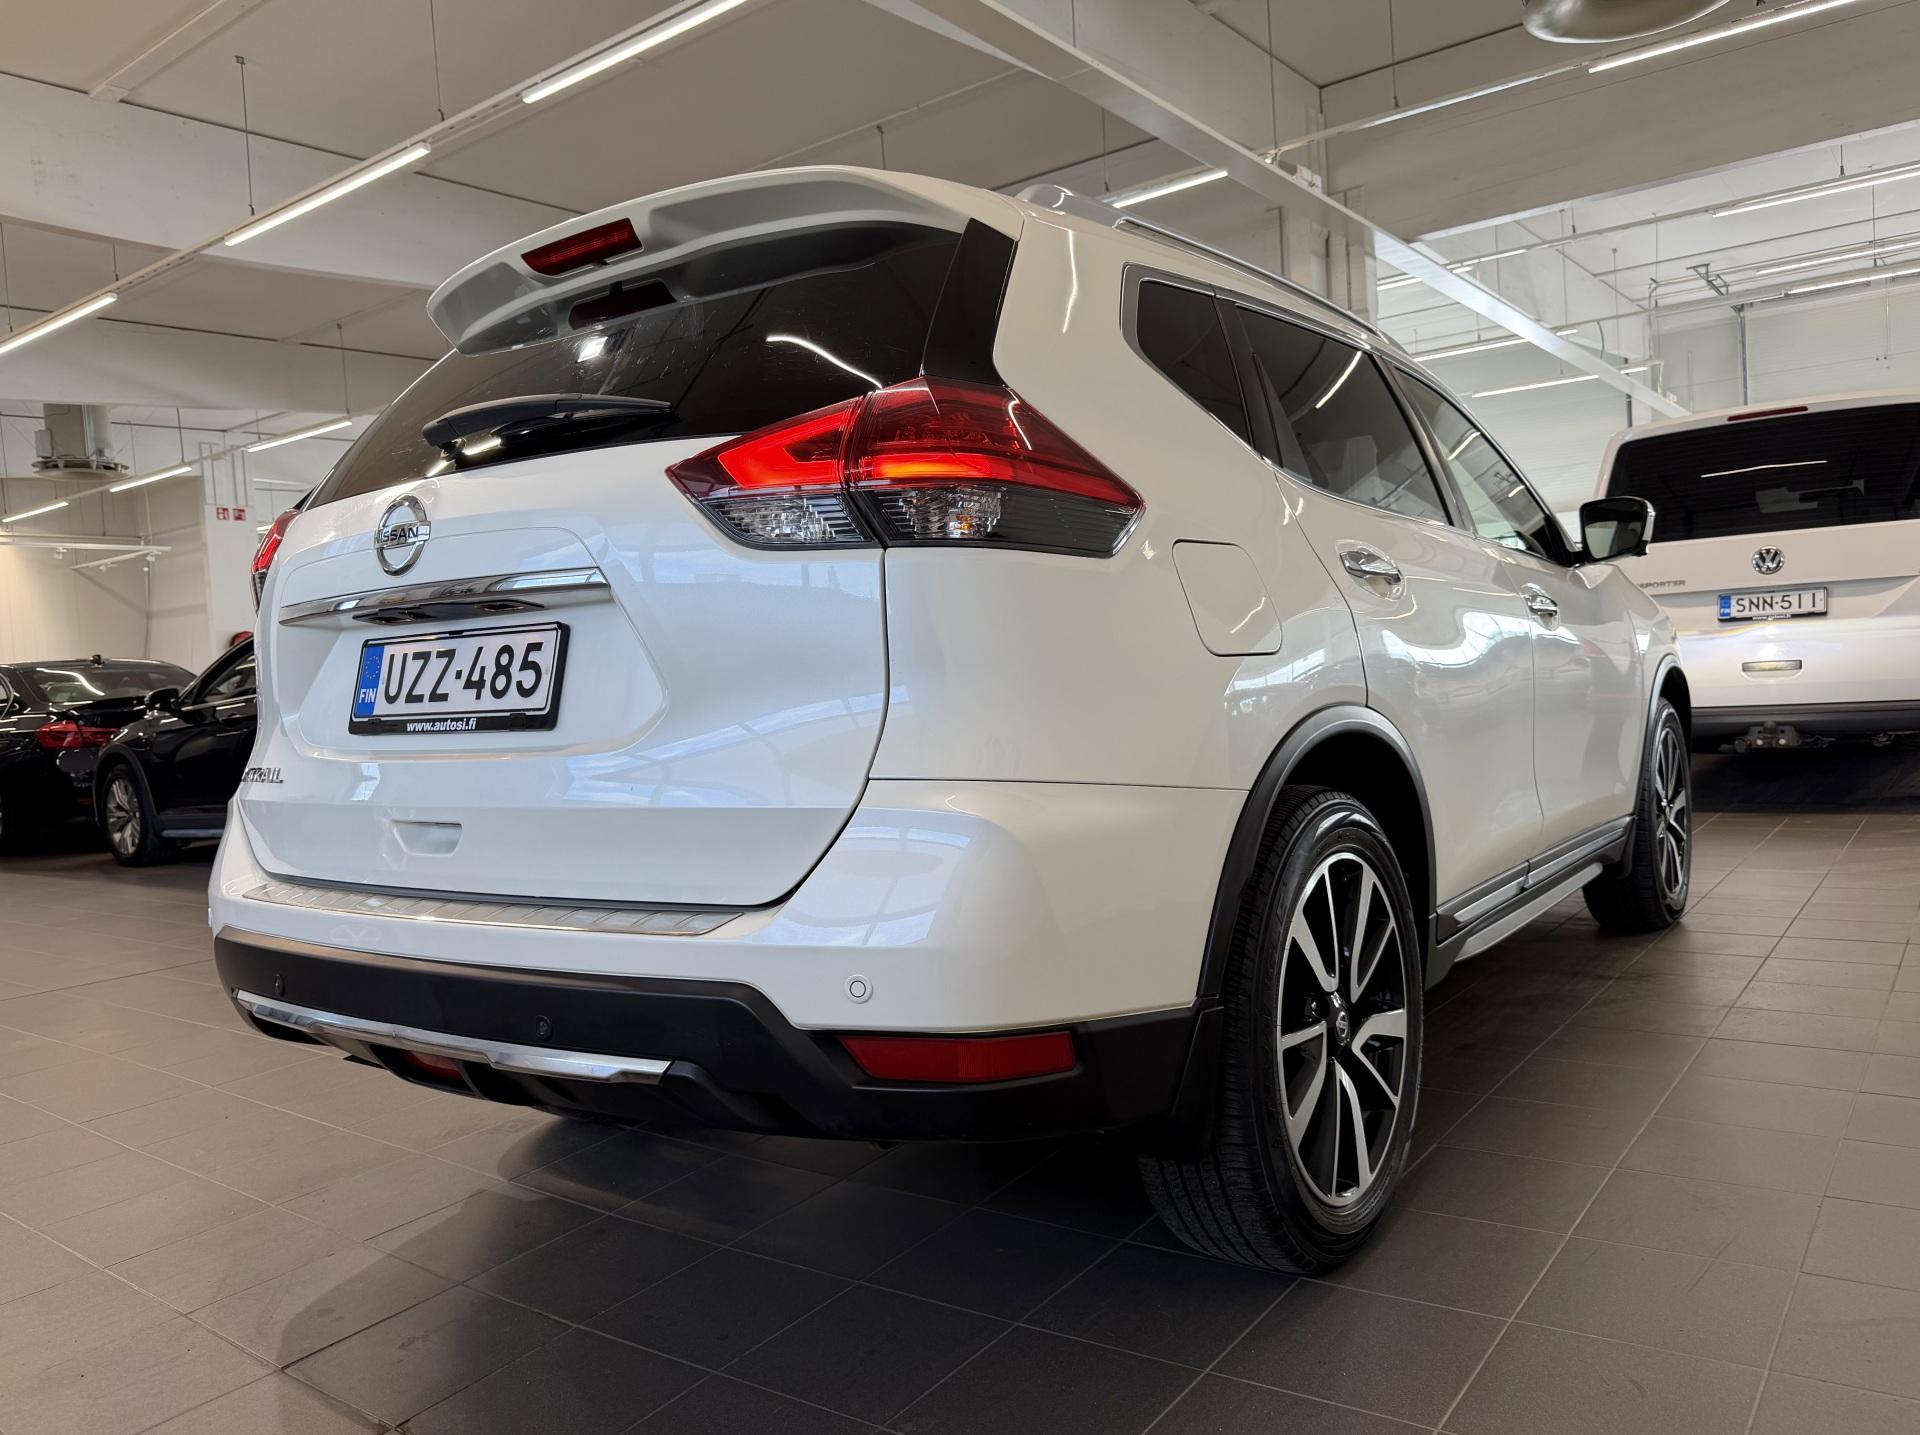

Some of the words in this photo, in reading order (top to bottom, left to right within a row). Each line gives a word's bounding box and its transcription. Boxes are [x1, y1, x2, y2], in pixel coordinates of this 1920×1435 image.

[376, 526, 419, 544] NISSAN
[1736, 592, 1816, 613] SNN-511
[359, 688, 376, 703] FIN
[384, 641, 544, 705] UZZ-485
[406, 717, 477, 732] www.autosi.fi
